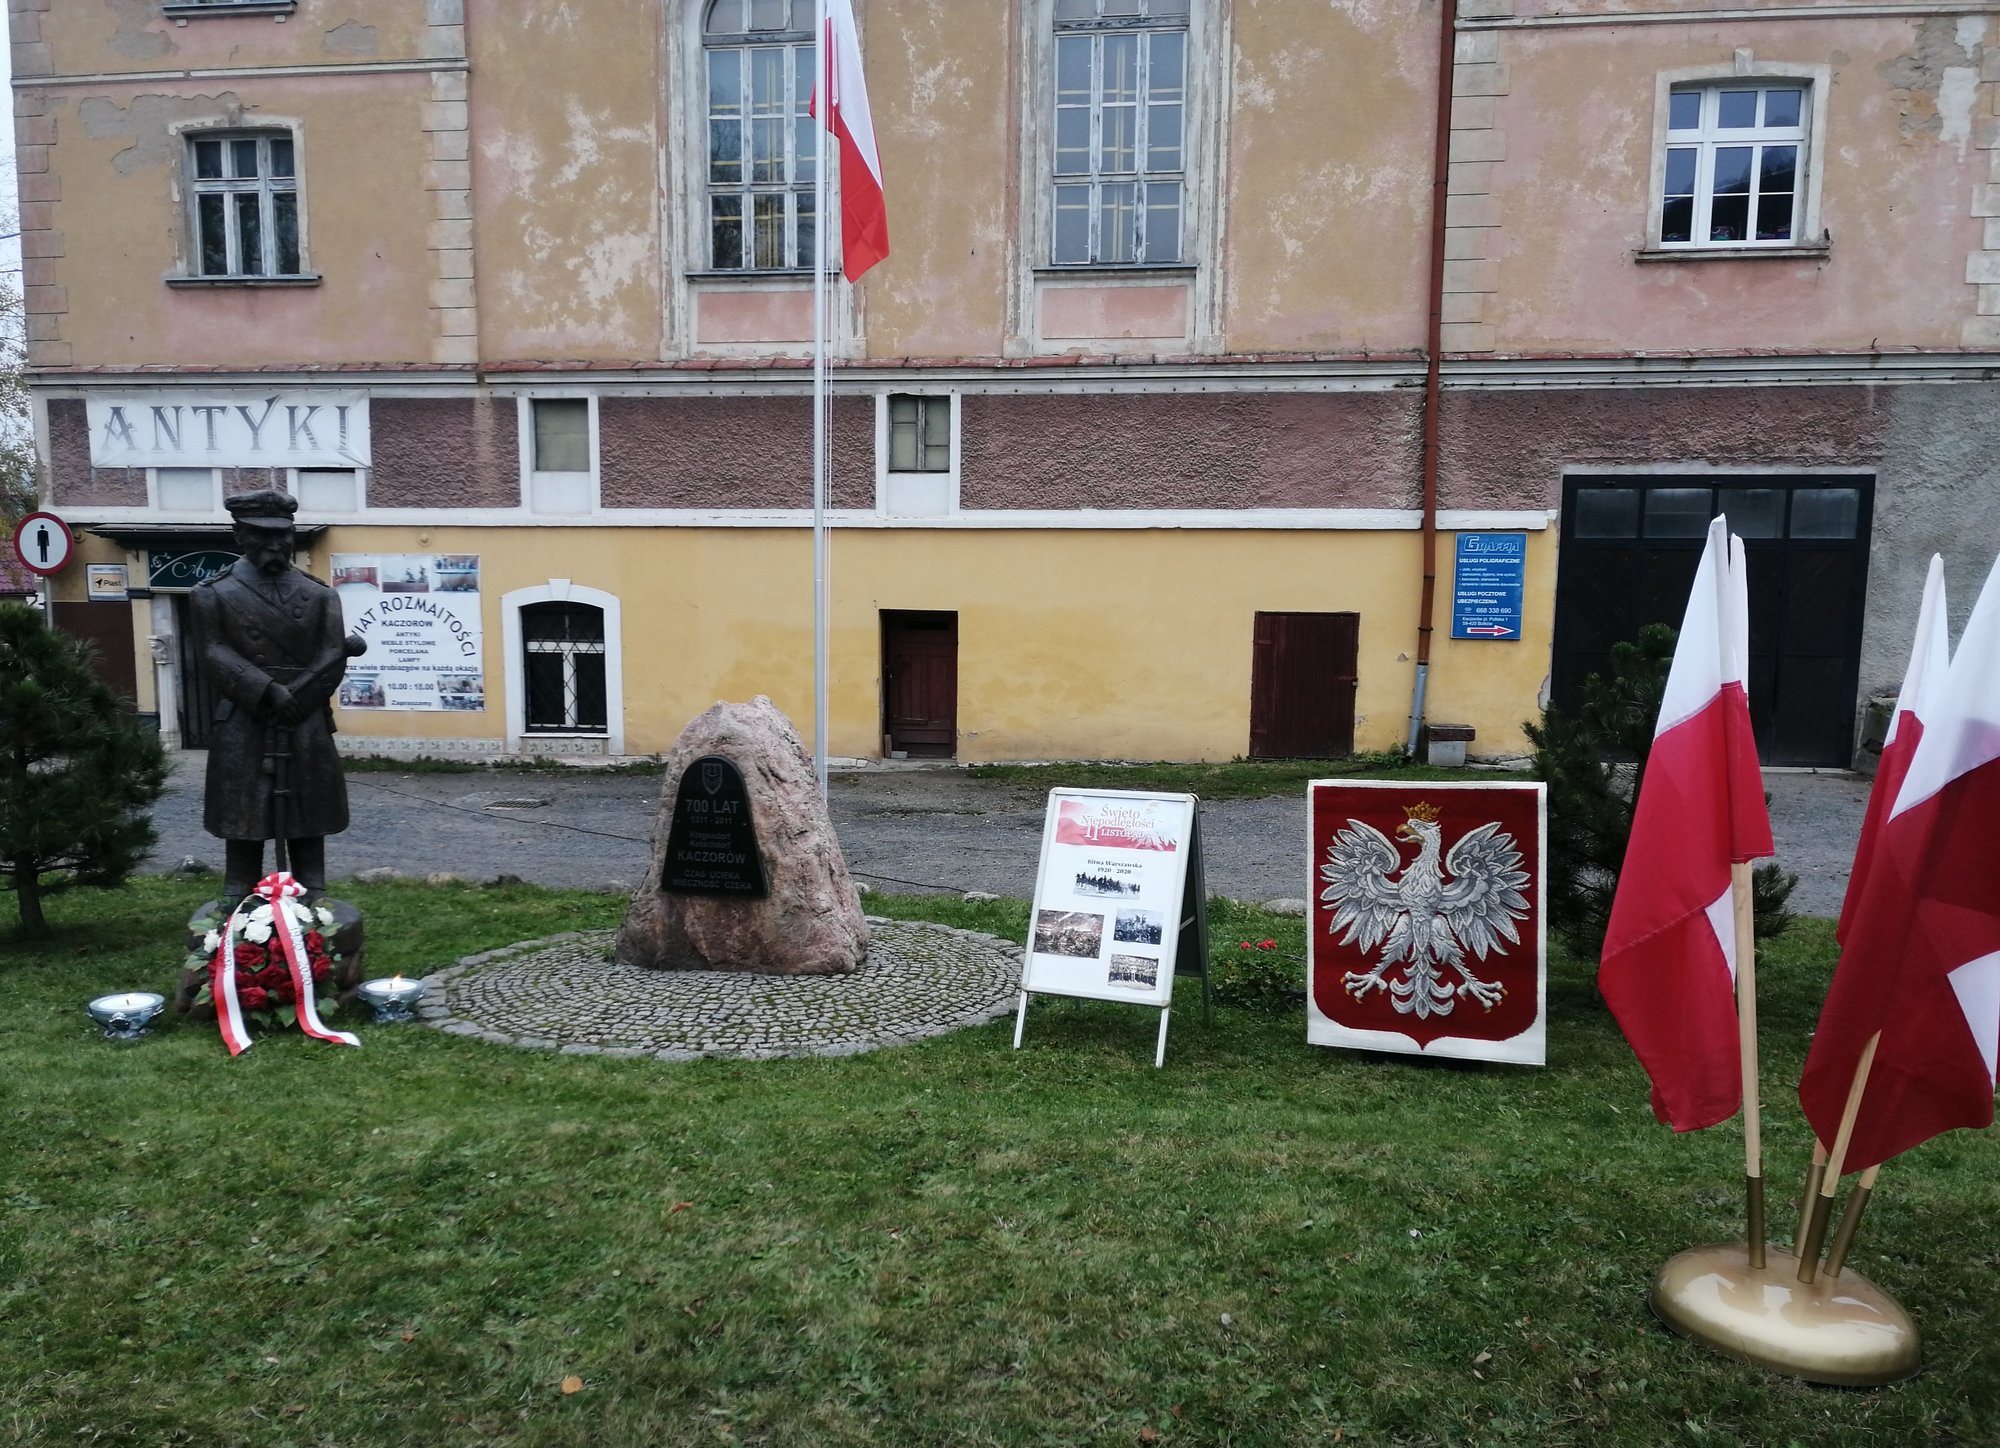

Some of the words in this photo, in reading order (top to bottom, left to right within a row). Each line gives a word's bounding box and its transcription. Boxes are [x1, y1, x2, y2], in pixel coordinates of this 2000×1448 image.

[101, 394, 351, 453] ANTYKI
[103, 579, 122, 587] Piast
[380, 596, 476, 656] ROZMAITOŚCI
[685, 799, 709, 813] 700
[713, 799, 739, 814] LAT
[714, 816, 733, 824] 2011
[1081, 815, 1155, 830] Niepodległości
[677, 849, 746, 864] KACZORÓW
[1105, 860, 1142, 868] Warszawska
[683, 869, 706, 878] CZAS
[709, 870, 741, 880] UCIEKA
[724, 880, 753, 890] CZEKA
